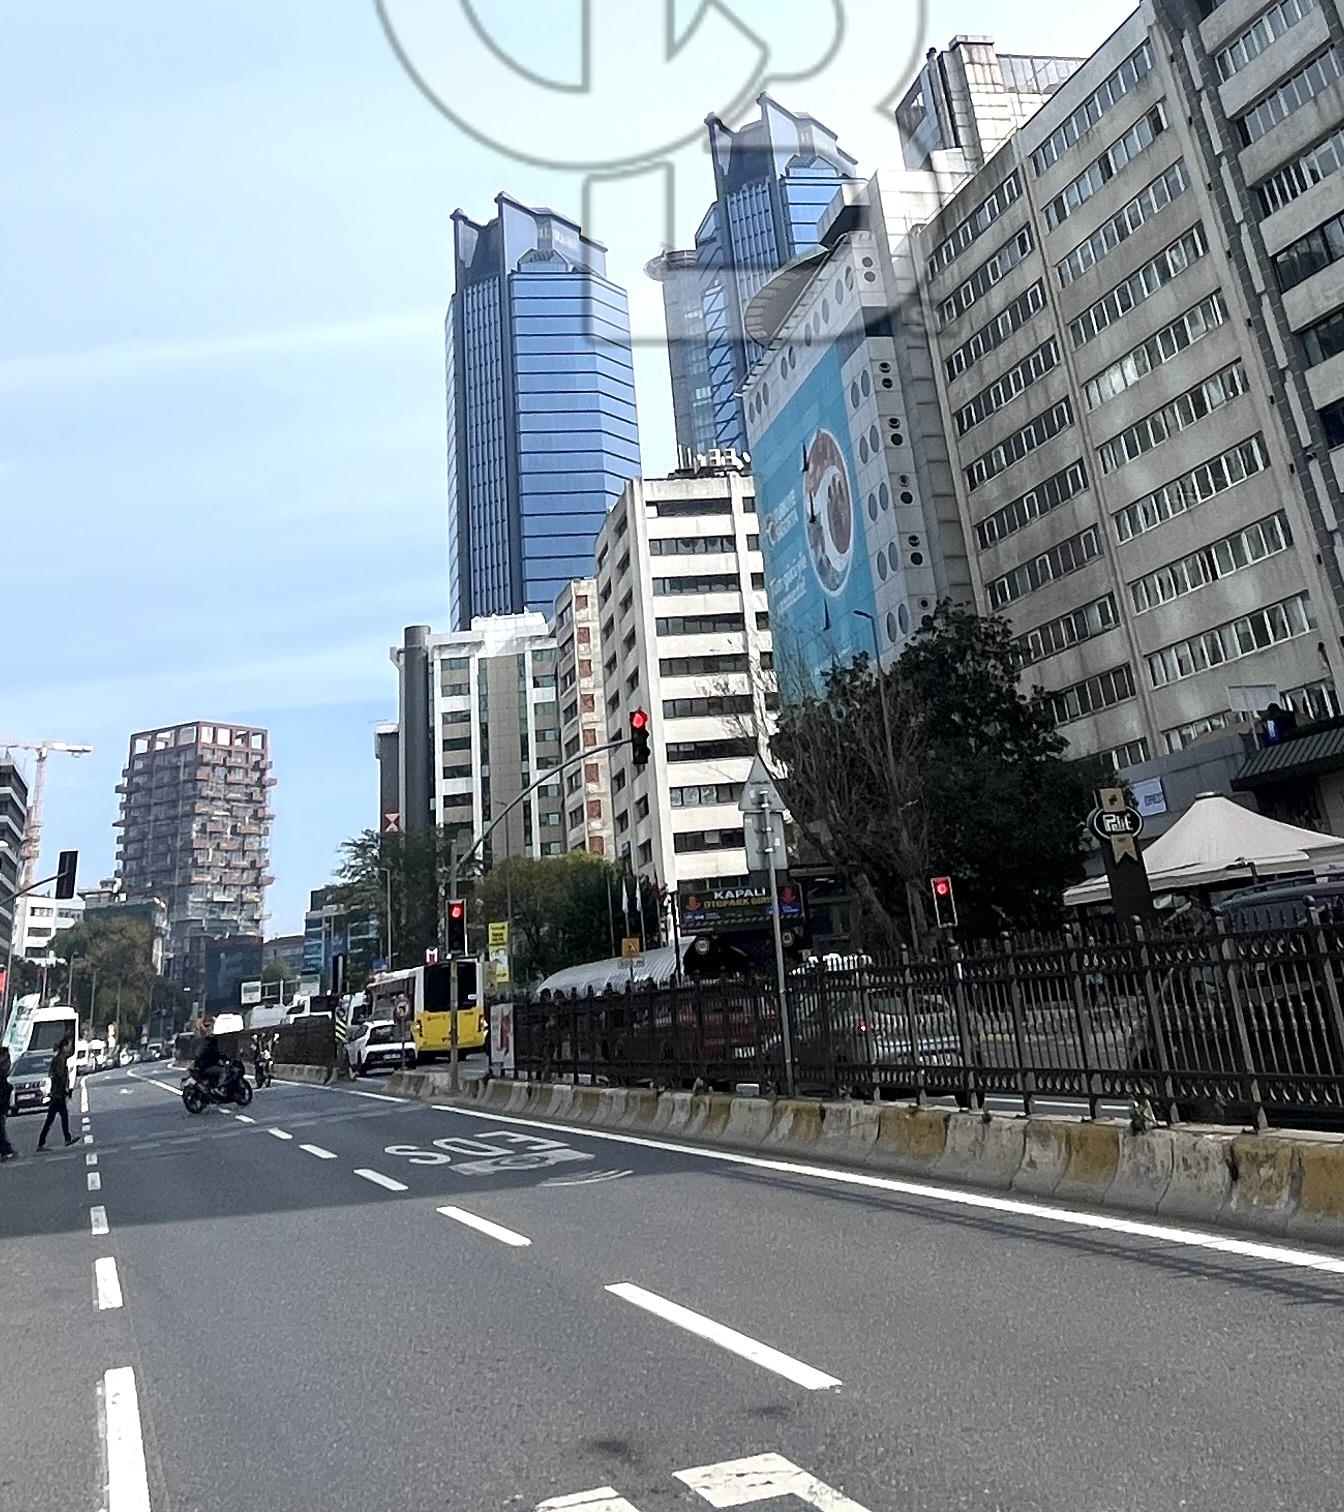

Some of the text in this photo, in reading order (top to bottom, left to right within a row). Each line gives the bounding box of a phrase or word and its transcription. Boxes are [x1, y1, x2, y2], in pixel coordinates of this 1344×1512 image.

[714, 887, 766, 900] KAPALI
[703, 897, 749, 909] OTOPARK
[384, 1130, 569, 1166] EDS
